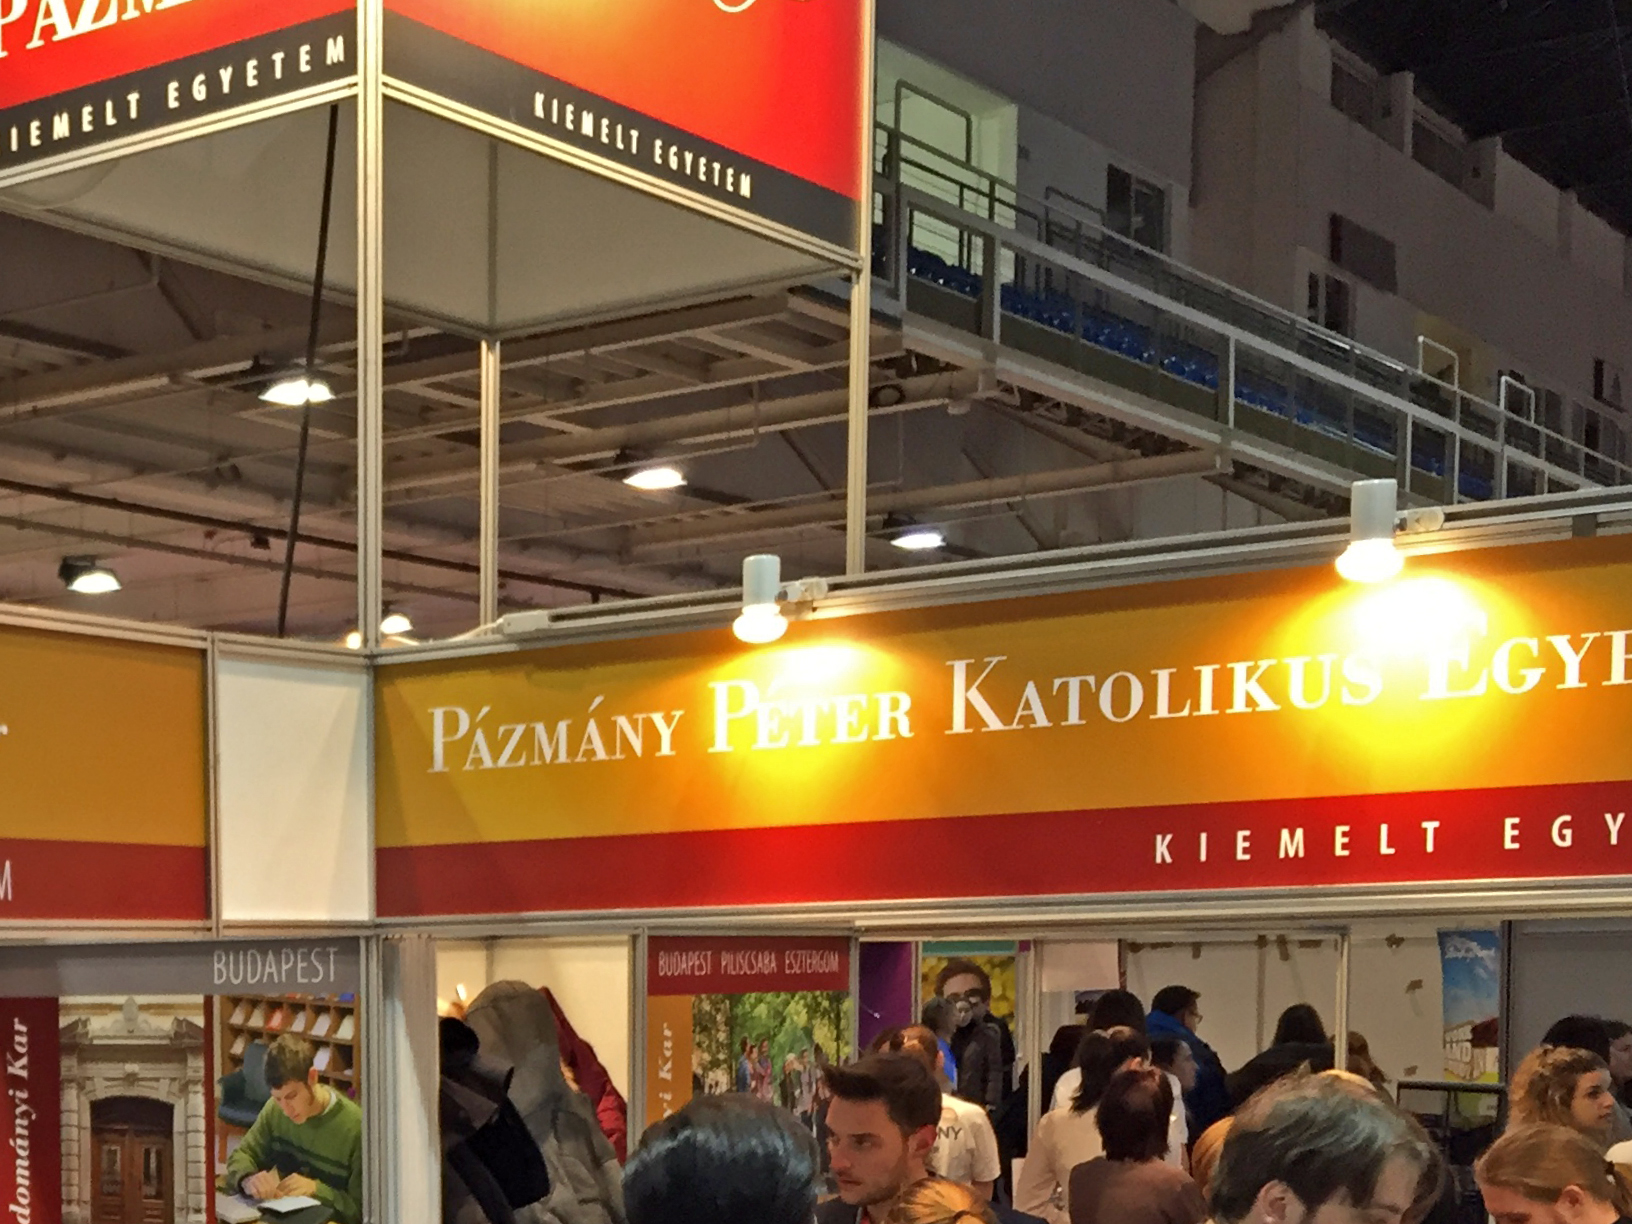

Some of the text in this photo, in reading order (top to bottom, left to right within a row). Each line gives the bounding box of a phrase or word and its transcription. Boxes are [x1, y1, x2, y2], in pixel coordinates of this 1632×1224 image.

[167, 35, 345, 109] EGYETEM
[533, 91, 751, 199] KIEMELT EGYETEM
[427, 695, 685, 774] PÁZMÁNY
[944, 652, 1384, 734] KATOLIKUS
[1155, 812, 1625, 864] KIEMELT EGY
[213, 947, 339, 986] BUDAPEST
[658, 950, 839, 977] BUDAPEST PILISCSABA ESZTERGOM
[6, 1018, 31, 1081] Kar
